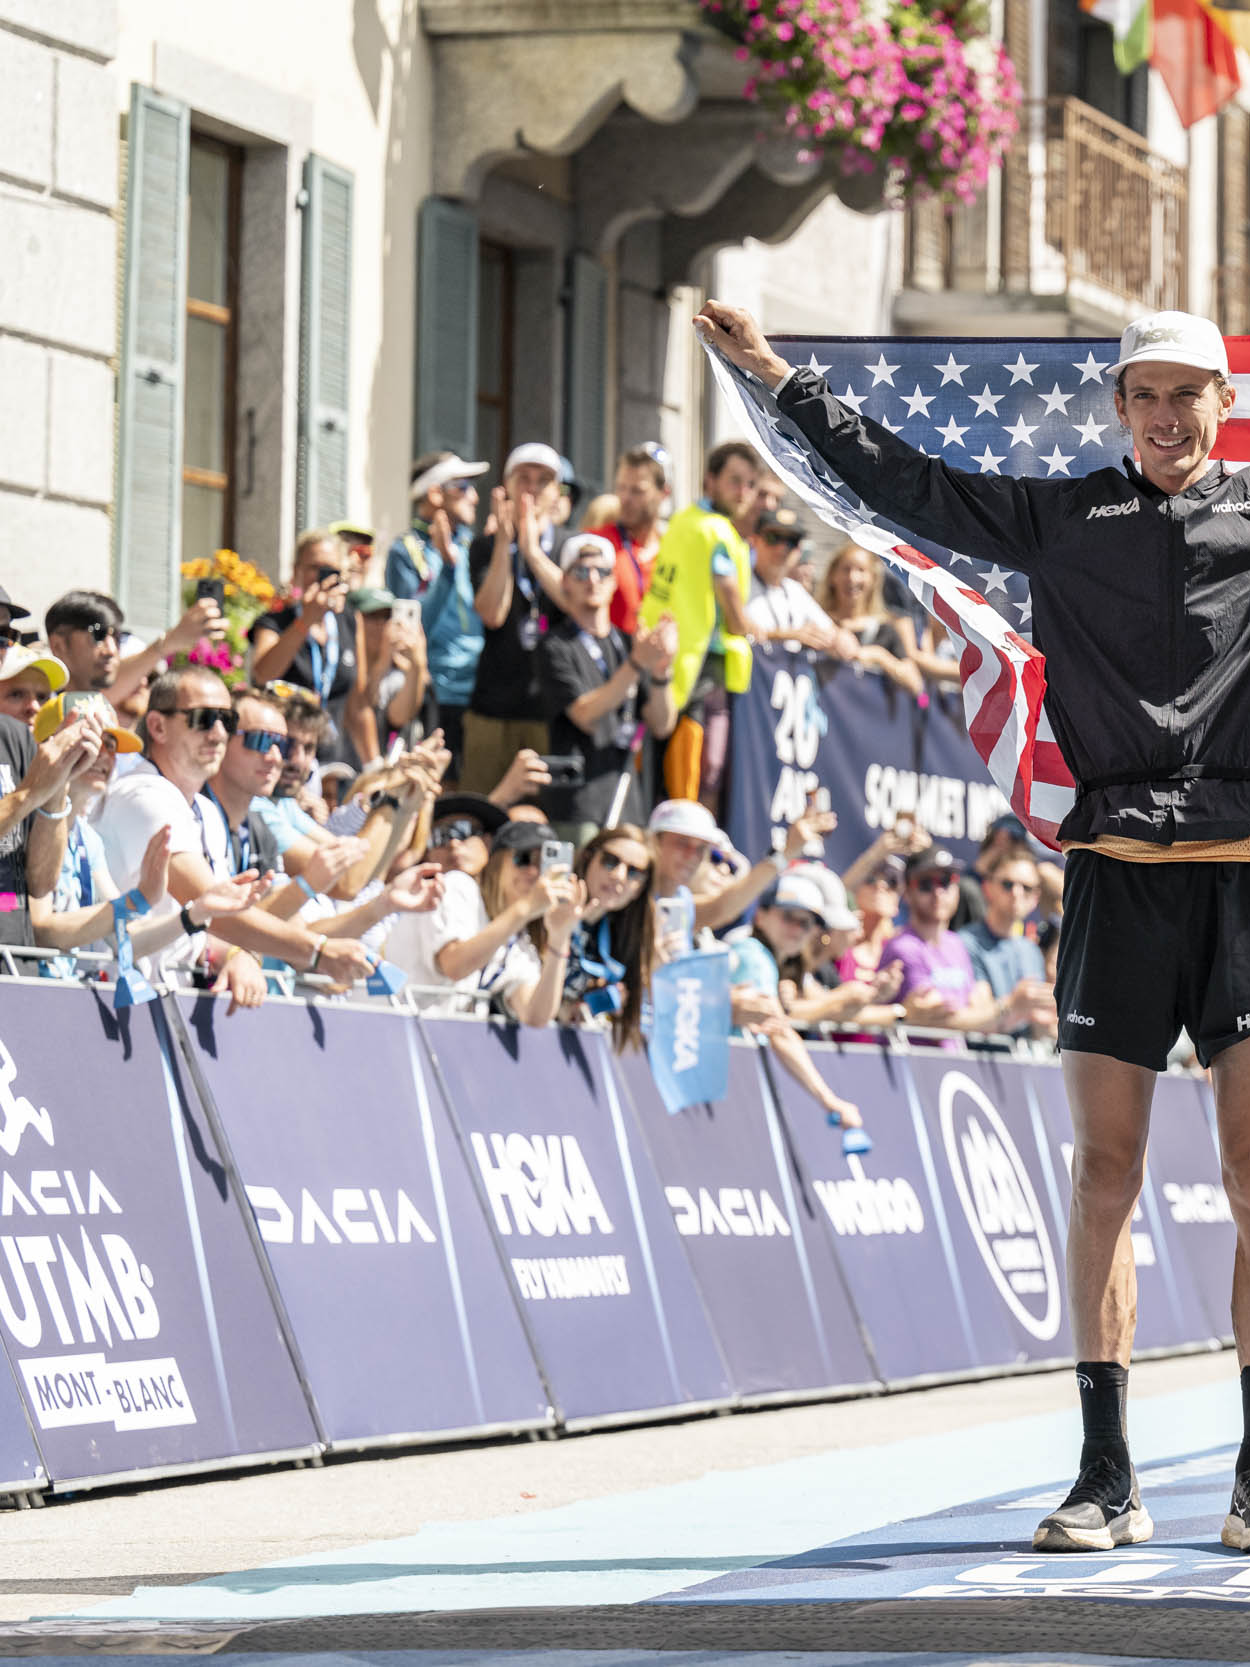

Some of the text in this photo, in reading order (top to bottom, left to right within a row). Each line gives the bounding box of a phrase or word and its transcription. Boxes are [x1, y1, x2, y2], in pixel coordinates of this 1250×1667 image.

[1086, 496, 1140, 520] HOKA
[671, 977, 703, 1073] HOKA
[246, 1184, 437, 1245] DACIA
[470, 1132, 615, 1237] HOKA
[664, 1186, 792, 1238] DACIA
[811, 1152, 925, 1237] wahoo
